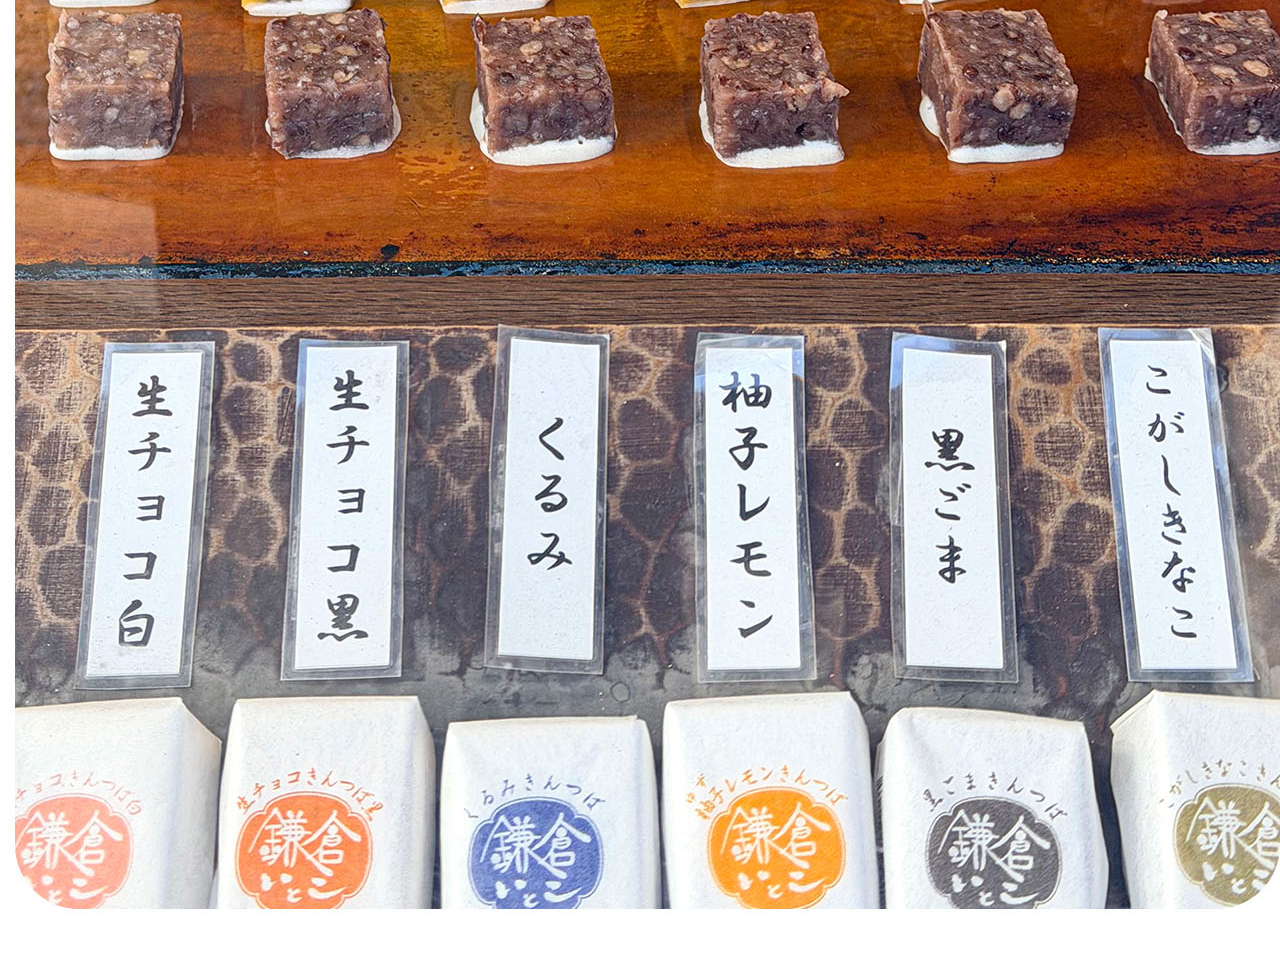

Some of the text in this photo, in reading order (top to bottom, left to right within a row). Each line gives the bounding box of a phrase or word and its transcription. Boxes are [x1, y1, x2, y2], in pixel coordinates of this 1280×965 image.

[118, 375, 173, 647] 生チョコ白
[317, 369, 370, 642] 生チョコ黒
[527, 417, 573, 571] くるみ
[719, 371, 774, 638] 柚子レモン
[924, 428, 975, 584] 黒ごま
[1146, 365, 1198, 638] こがしきなこ
[15, 770, 143, 816] チョコきんつば白
[464, 773, 606, 819] くるみきんつば
[15, 811, 123, 878] 鎌倉
[248, 807, 362, 877] 鎌倉
[480, 812, 592, 879] 鎌倉
[721, 802, 831, 869] 鎌倉
[938, 809, 1051, 882] 鎌倉
[1185, 796, 1280, 870] 鎌倉
[260, 873, 347, 904] いとこ
[495, 879, 583, 909] いとこ
[738, 871, 827, 899] いとこ
[951, 874, 1039, 907] いとこ
